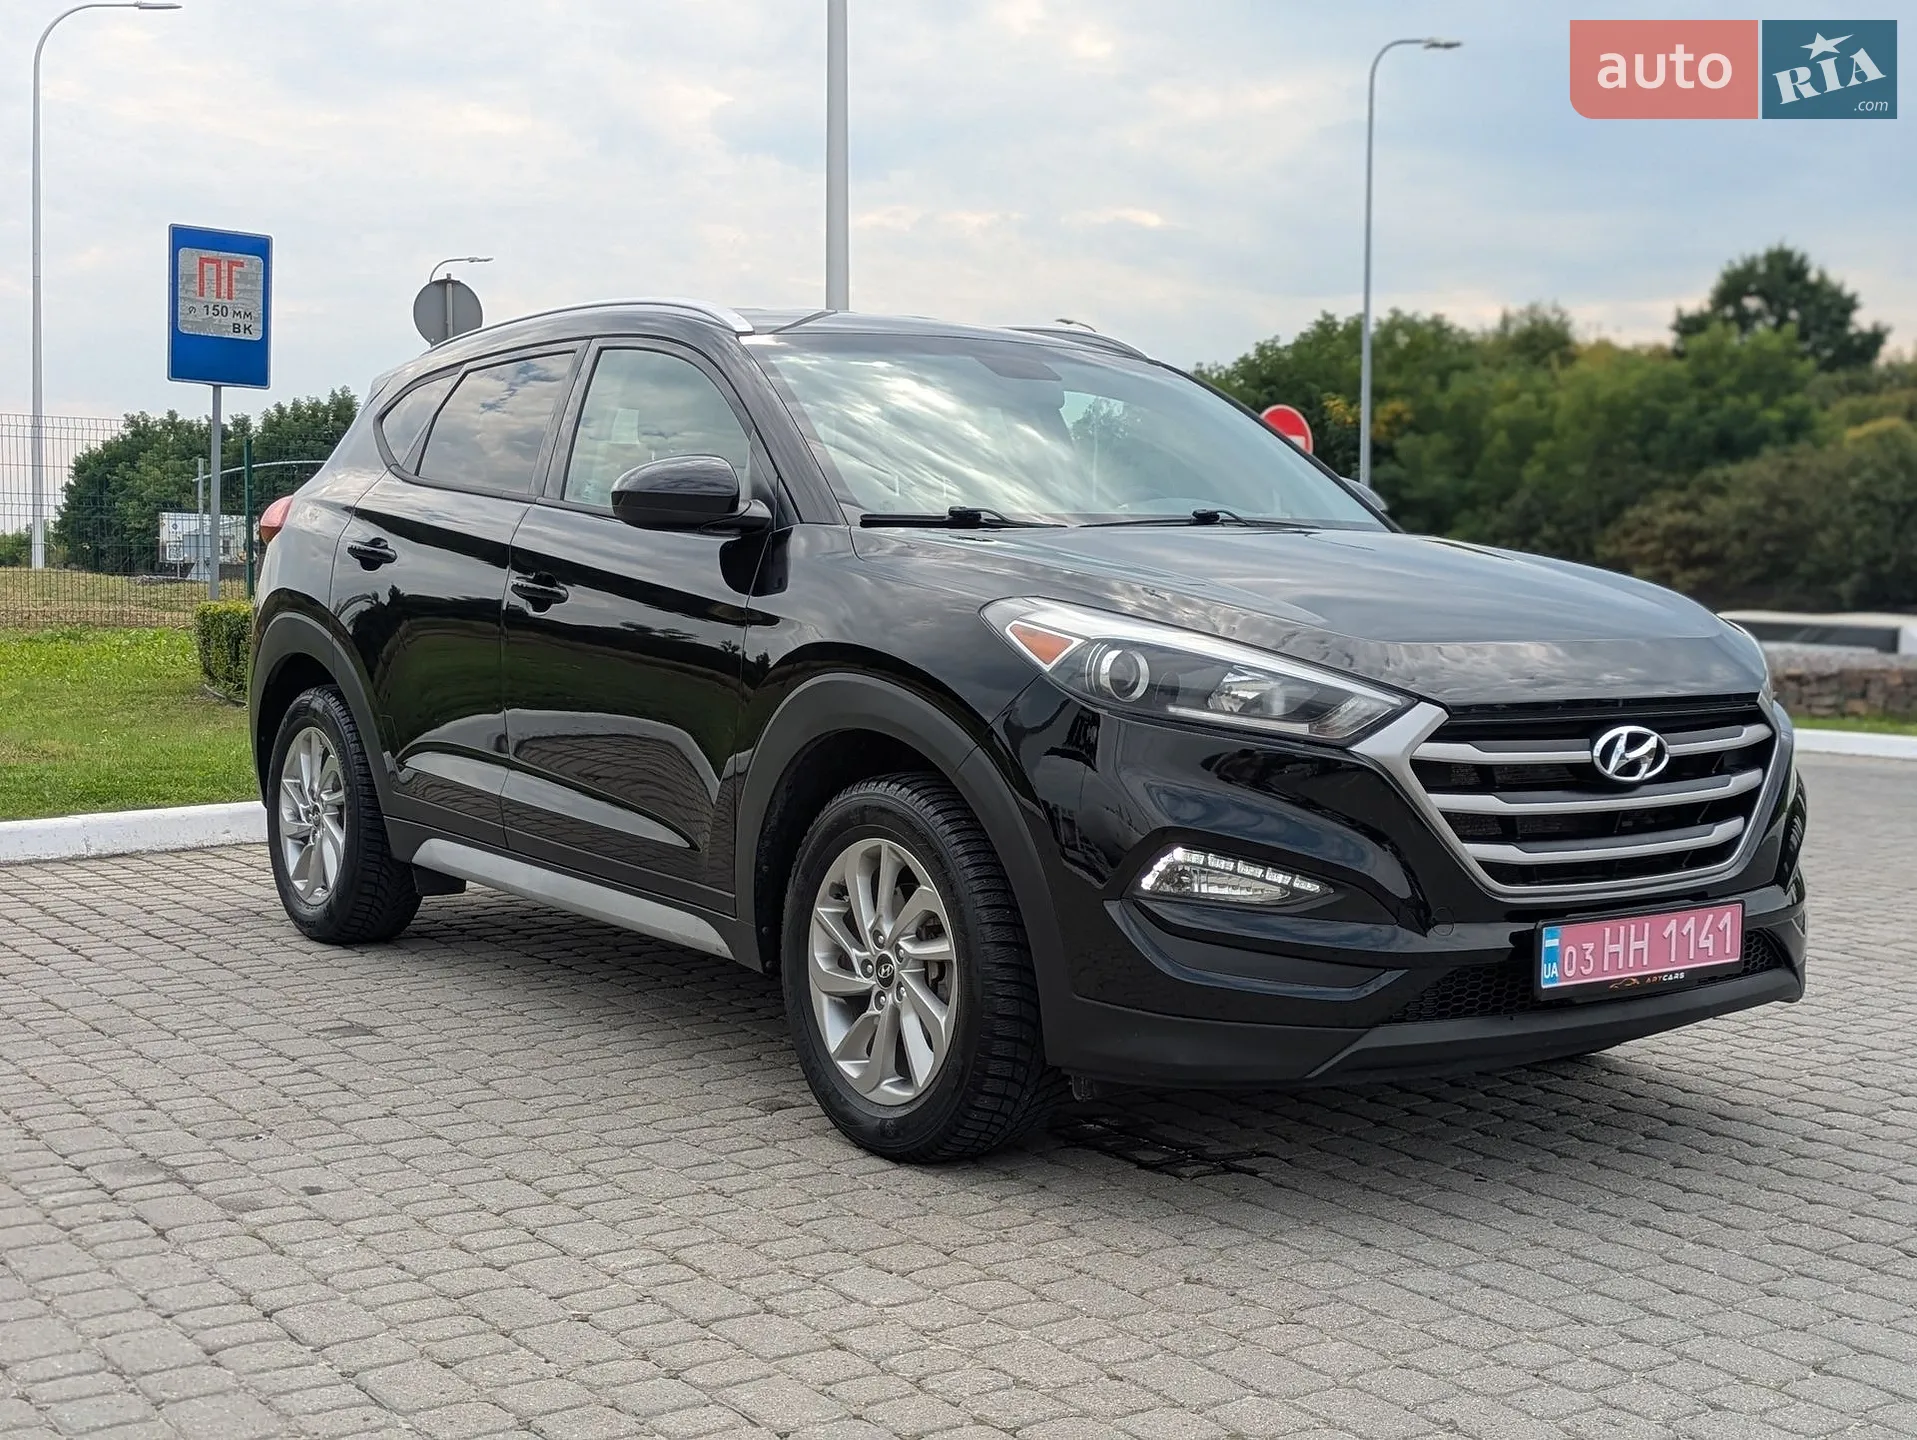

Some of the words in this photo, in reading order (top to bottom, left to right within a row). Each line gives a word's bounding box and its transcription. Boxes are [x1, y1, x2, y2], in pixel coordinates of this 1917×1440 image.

[197, 256, 245, 301] ПГ
[203, 304, 229, 318] 150
[1563, 942, 1595, 978] 03
[1603, 922, 1650, 972] HH
[1662, 911, 1732, 963] 1141
[1543, 963, 1559, 979] UA
